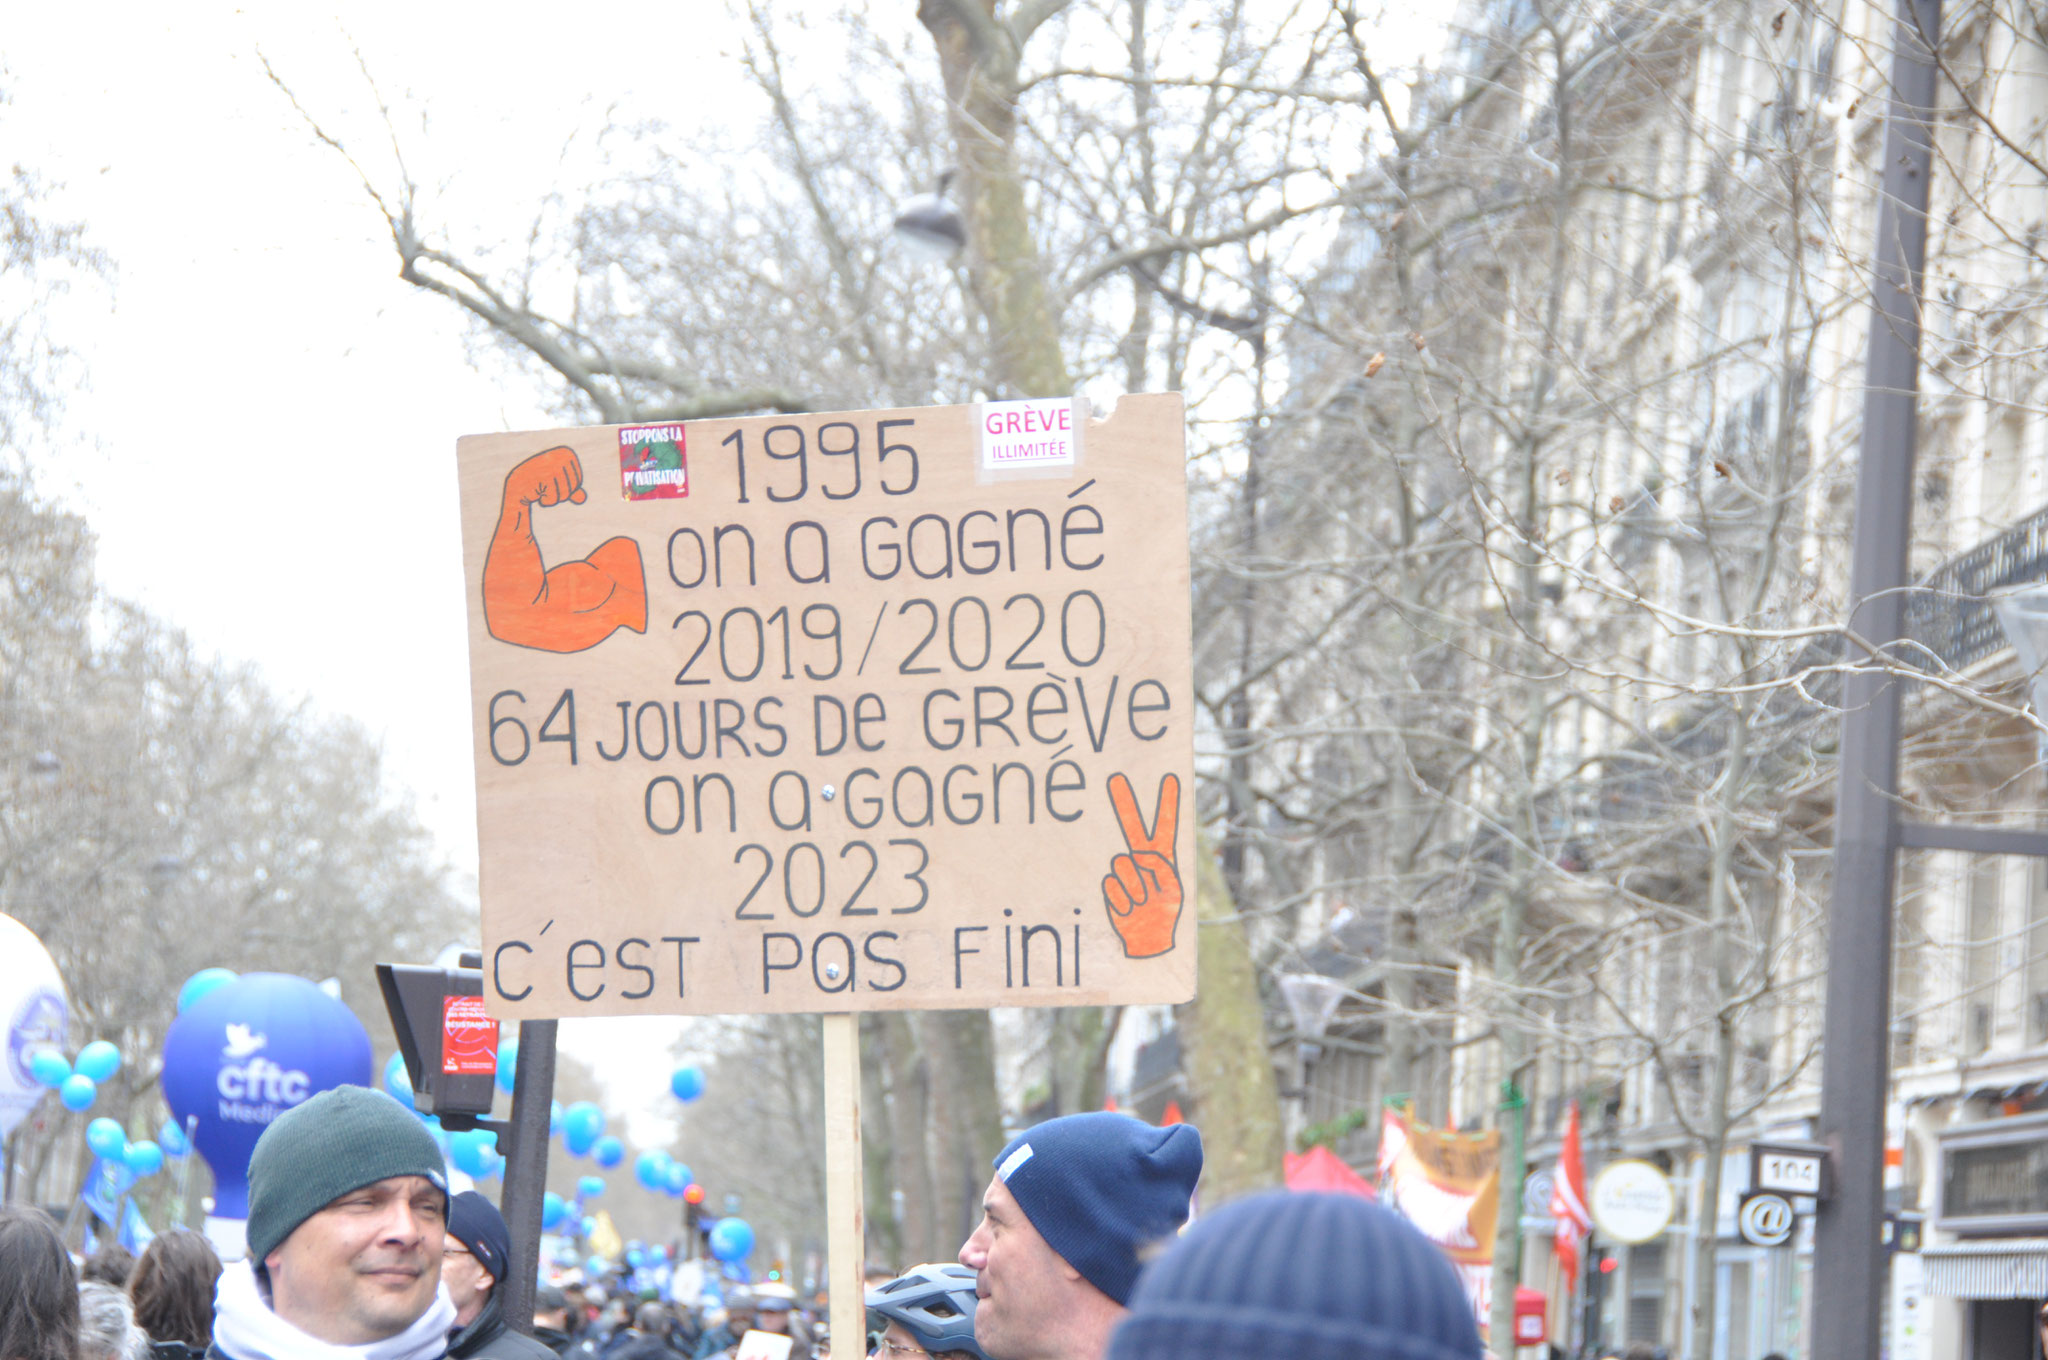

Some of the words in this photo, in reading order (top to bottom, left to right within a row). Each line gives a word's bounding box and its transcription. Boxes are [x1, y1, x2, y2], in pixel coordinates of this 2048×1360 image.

[621, 428, 669, 445] STOPPONS
[986, 404, 1071, 434] GRÈVE
[992, 438, 1067, 459] ILLIMITÉE
[722, 419, 919, 504] 1995
[666, 524, 756, 590] on
[785, 519, 830, 584] a
[672, 590, 1106, 686] 2019/2020
[488, 688, 578, 767] 64
[596, 696, 788, 762] JOURS
[644, 773, 737, 836] on
[768, 771, 812, 833] a
[734, 838, 930, 921] 2023
[216, 1057, 311, 1105] cftc
